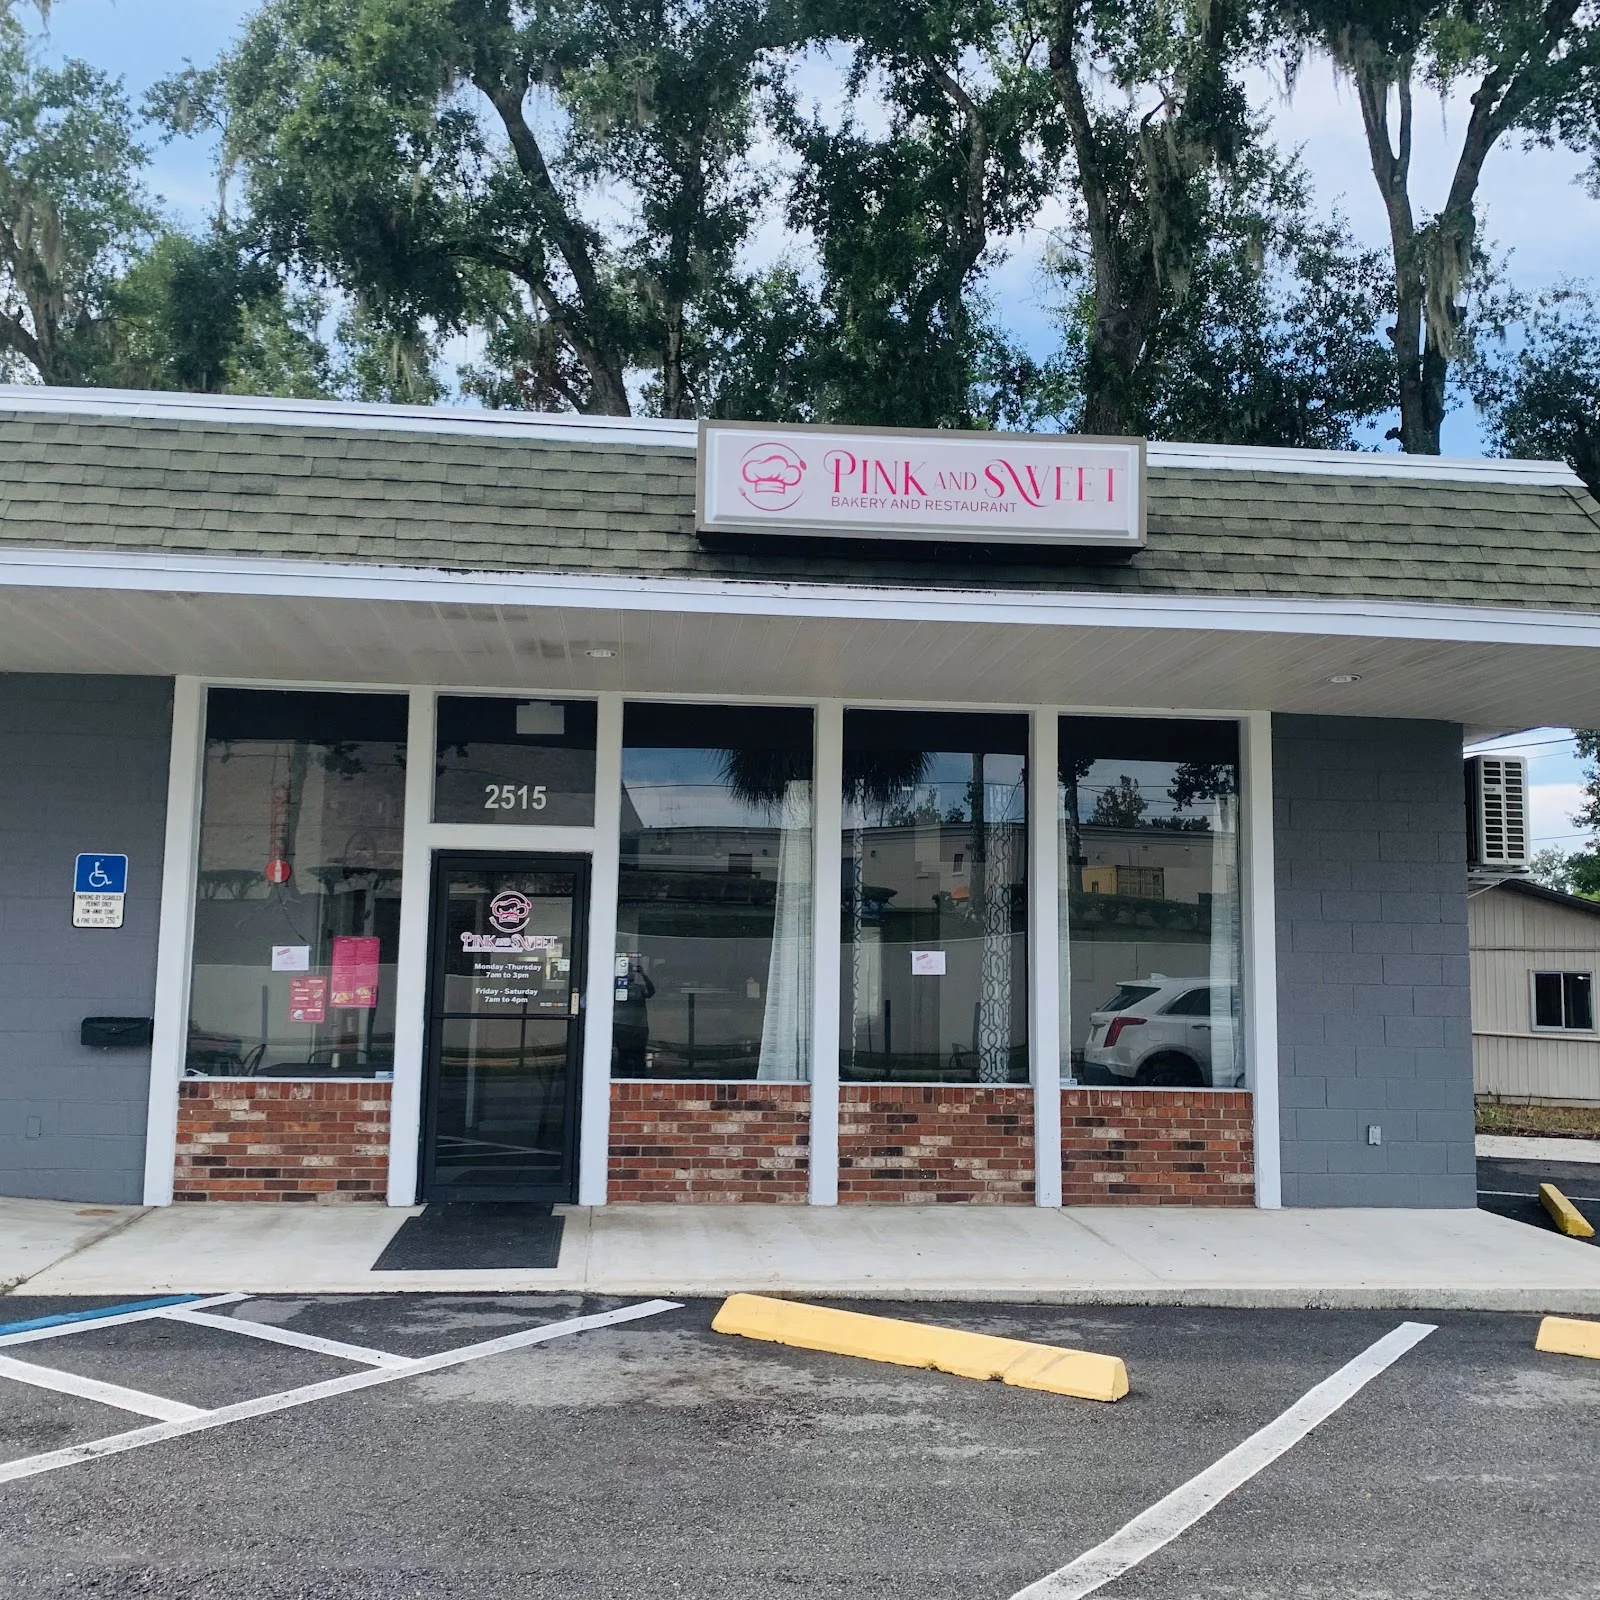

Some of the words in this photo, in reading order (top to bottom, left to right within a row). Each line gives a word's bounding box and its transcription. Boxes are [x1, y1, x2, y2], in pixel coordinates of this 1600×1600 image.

[823, 449, 928, 496] PINK
[934, 471, 977, 491] AND
[984, 458, 1124, 508] SWEET
[831, 496, 887, 509] BAKERY
[890, 499, 921, 510] AND
[925, 500, 1017, 513] RESTAURANT
[484, 784, 547, 810] 2515
[474, 963, 504, 971] Monday
[475, 988, 499, 996] Friday
[504, 988, 538, 996] Saturday
